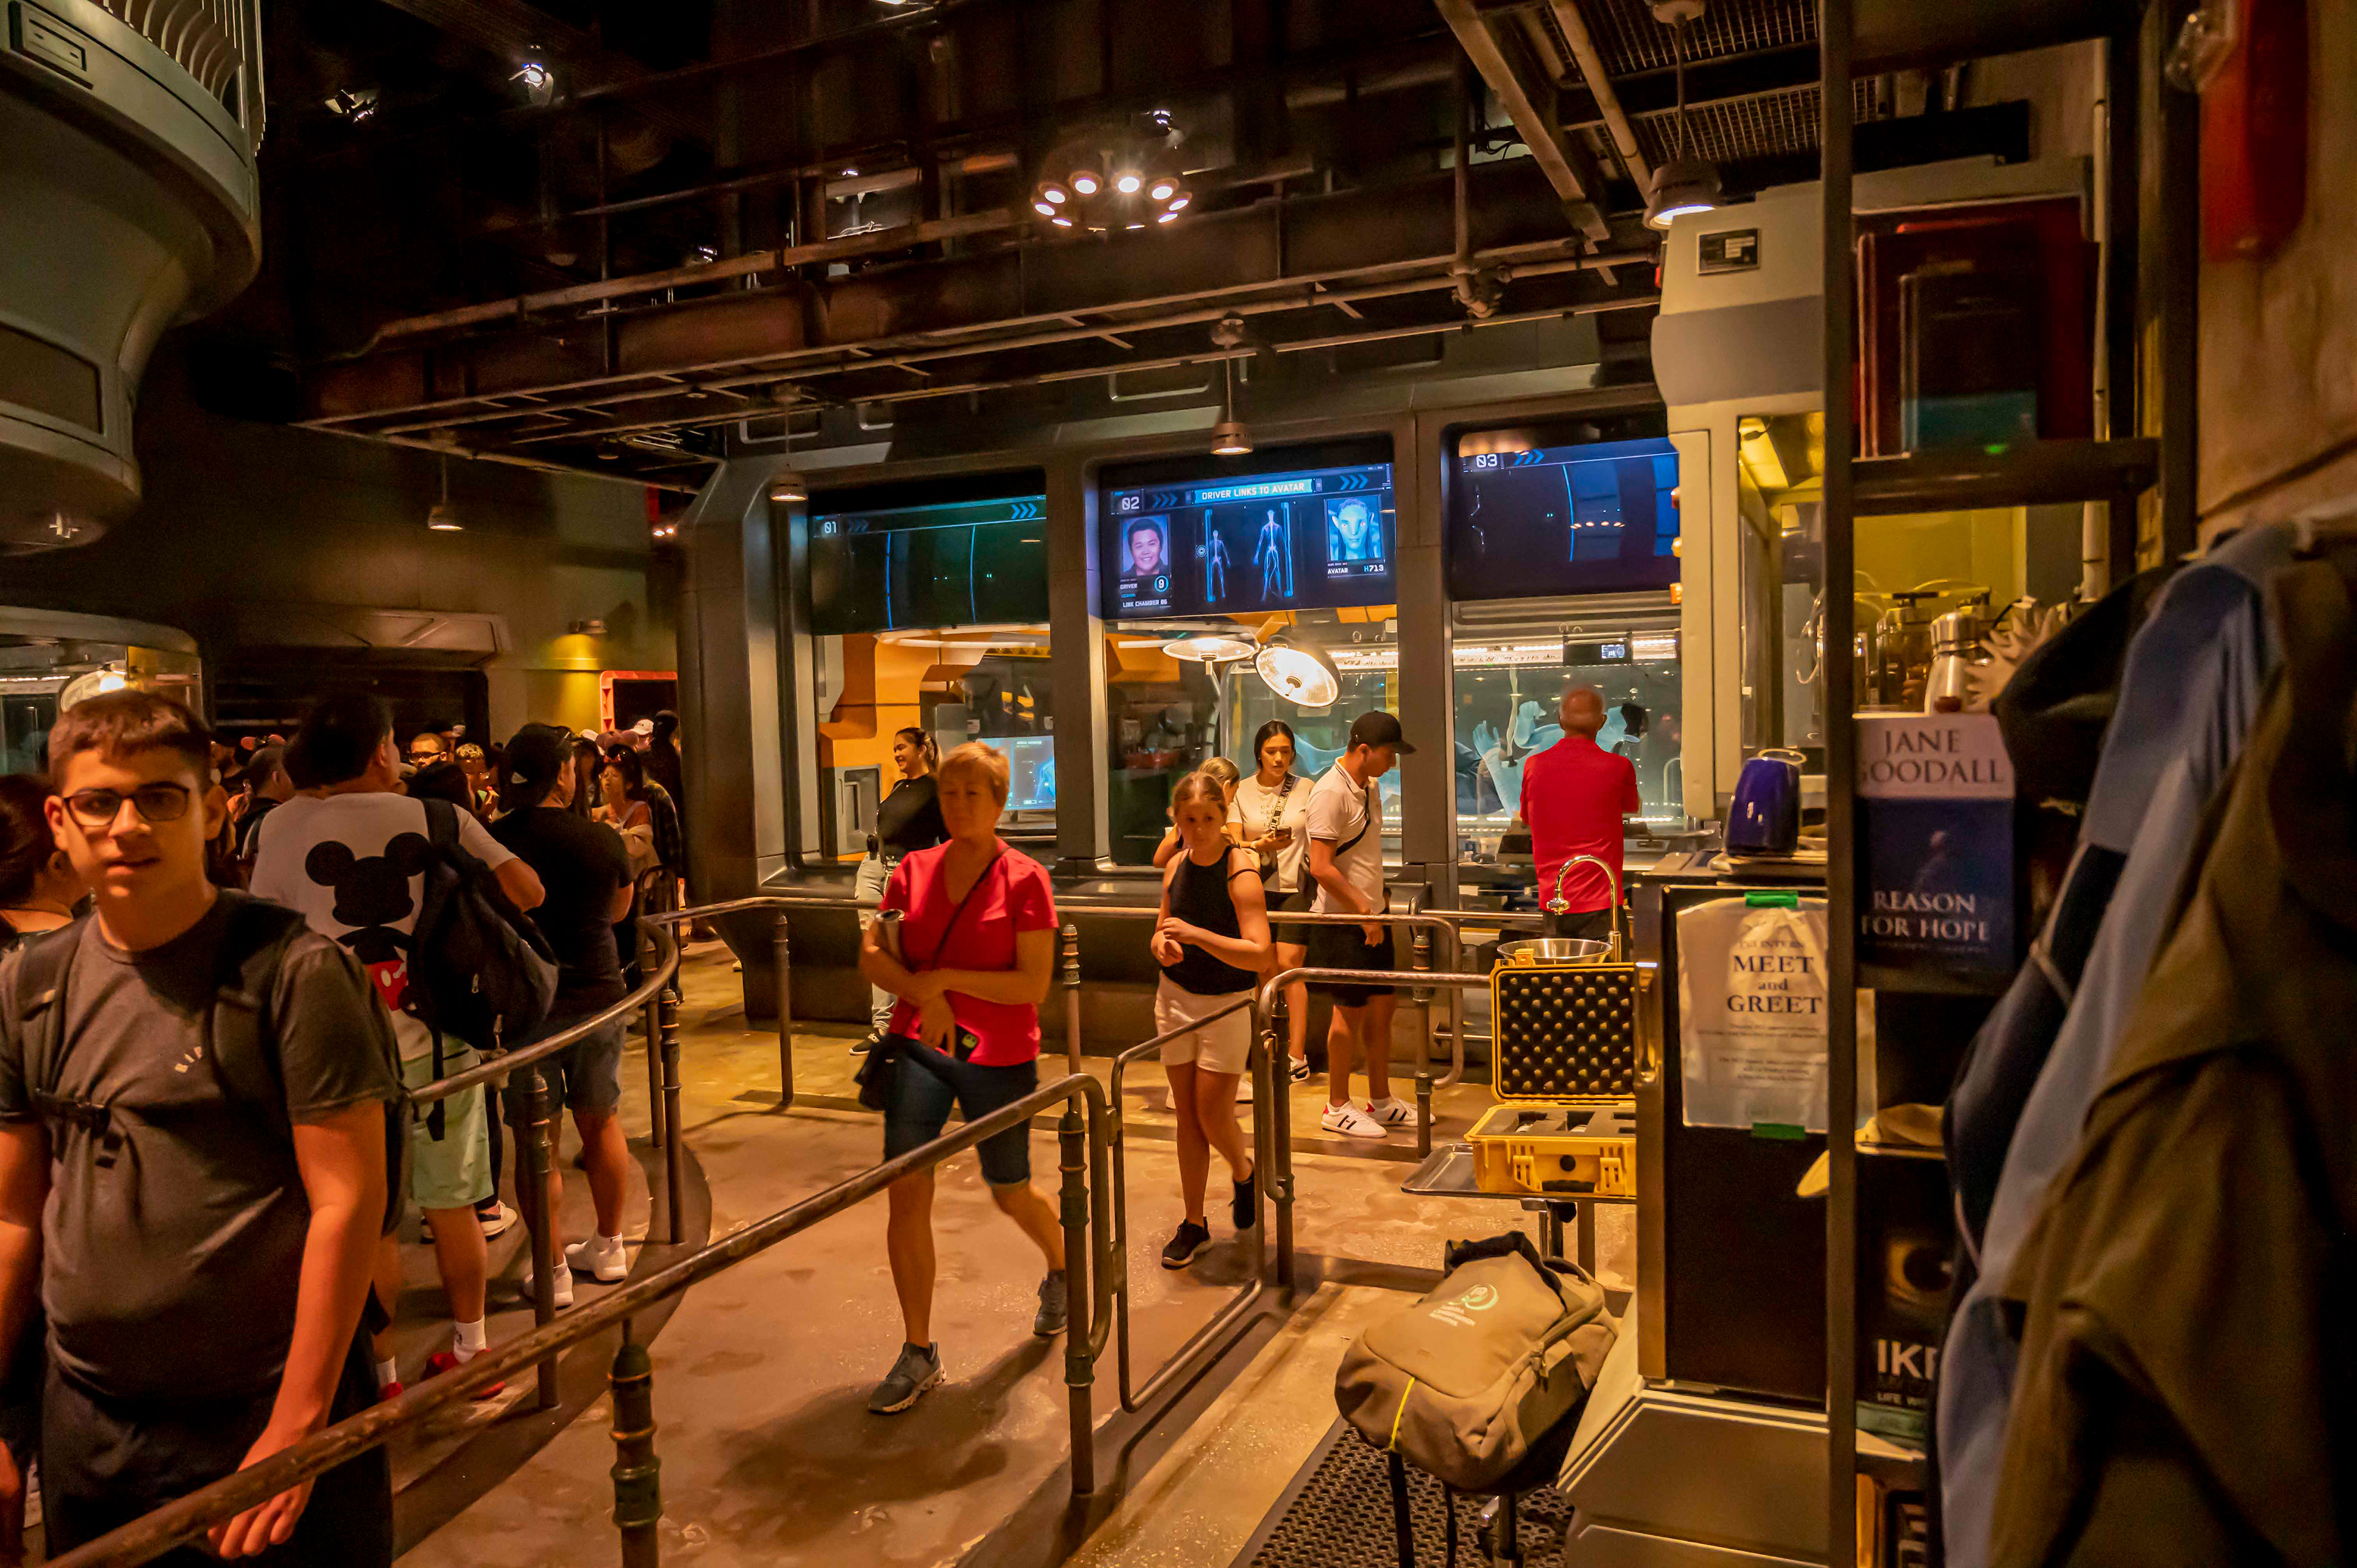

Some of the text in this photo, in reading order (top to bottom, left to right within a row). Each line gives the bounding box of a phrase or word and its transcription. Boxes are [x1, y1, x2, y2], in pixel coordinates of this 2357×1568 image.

[1476, 454, 1498, 468] 03
[1201, 482, 1304, 500] DRIVER LINKS TO AVATAR
[1121, 496, 1140, 511] 02
[824, 520, 837, 534] 01
[1364, 564, 1384, 573] H713
[1158, 578, 1165, 589] 9
[1884, 729, 1961, 758] JANE
[1873, 889, 1976, 915] REASON
[1860, 915, 1990, 943] FOR HOPE
[1733, 956, 1814, 974] MEET
[1758, 978, 1789, 991] and
[1727, 995, 1823, 1014] GREET
